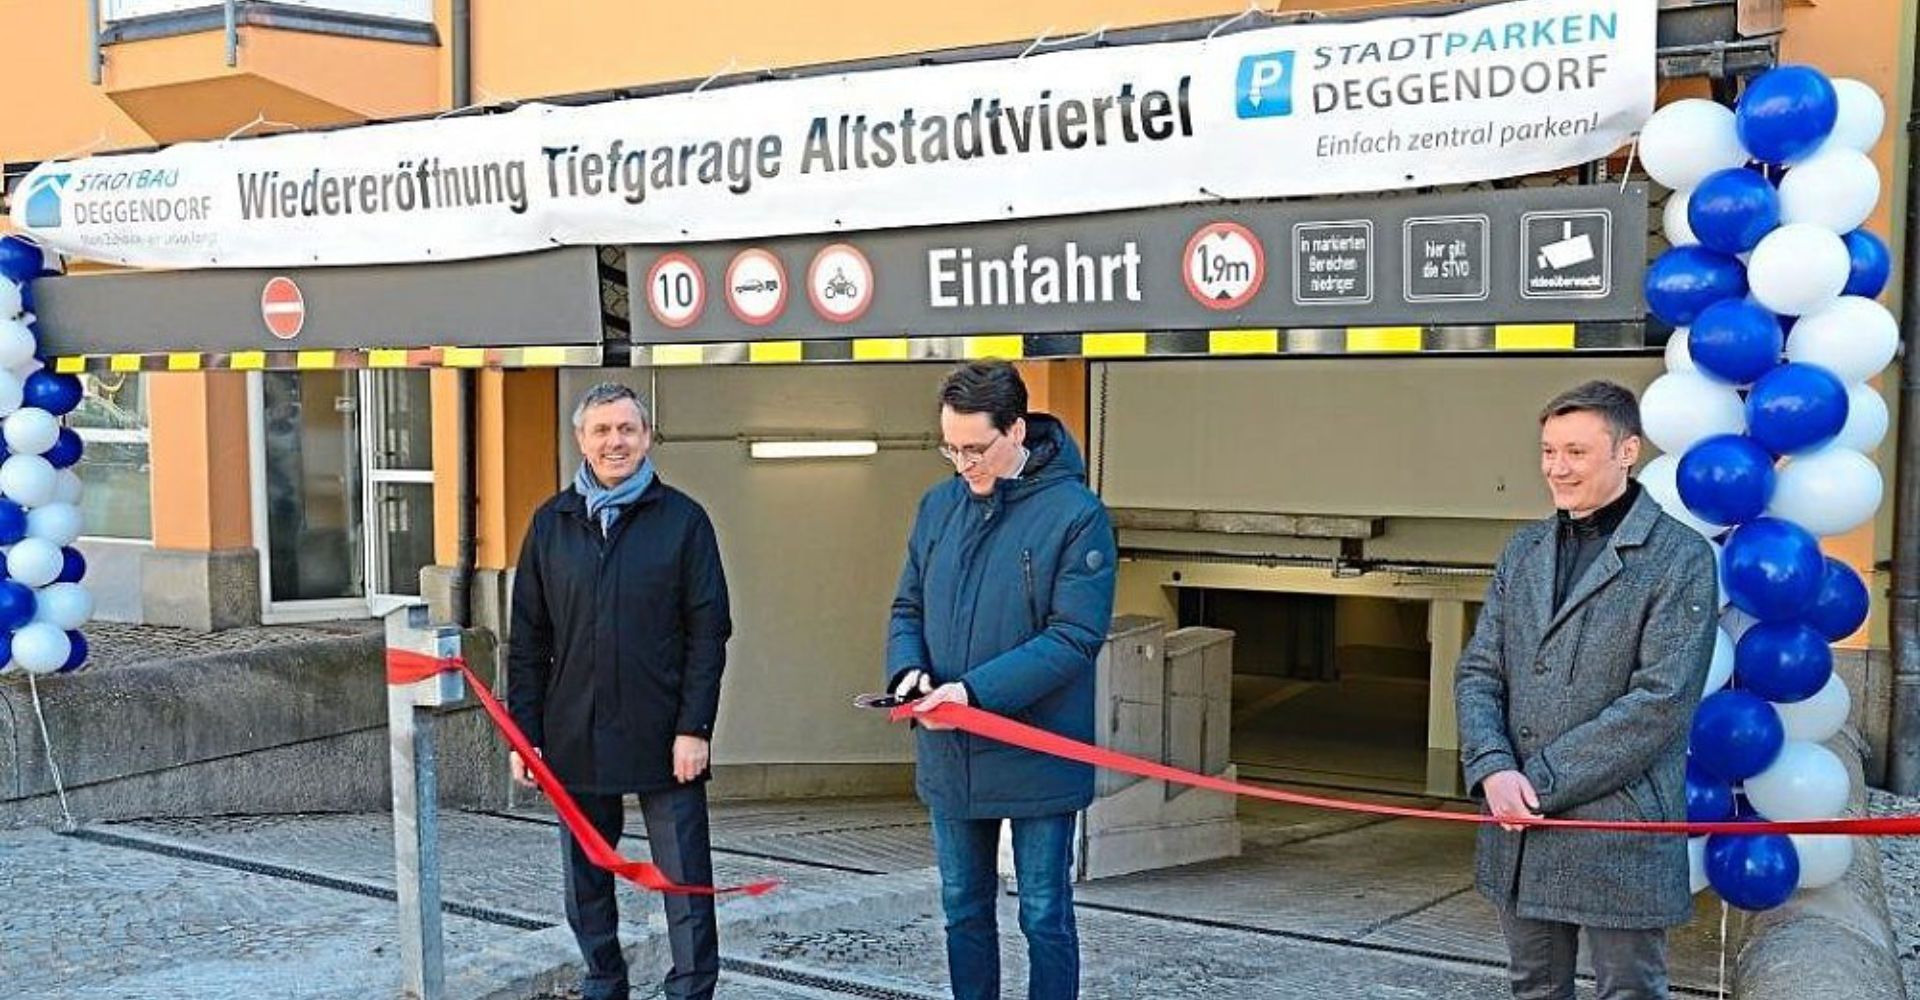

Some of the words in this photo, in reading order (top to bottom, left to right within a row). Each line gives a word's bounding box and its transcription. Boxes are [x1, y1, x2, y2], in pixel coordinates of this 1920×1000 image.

[1313, 11, 1618, 69] STADTPARKEN
[1312, 54, 1609, 115] DEGGENDORF
[237, 156, 528, 220] Wiedereröffnung
[542, 132, 782, 205] Tiefgarage
[800, 75, 1193, 174] Altstadtviertel
[1316, 125, 1401, 158] Einfach
[1407, 121, 1493, 150] zentral
[1500, 112, 1599, 146] parken!
[75, 168, 180, 192] STADTBAU
[74, 196, 212, 225] DEGGENDORF
[1300, 235, 1310, 253] in
[1312, 233, 1366, 252] markierten
[1425, 240, 1446, 258] hier
[1448, 239, 1467, 261] gilt
[928, 241, 1142, 307] Einfahrt
[1197, 243, 1249, 284] 1,9m
[1308, 254, 1358, 272] Bereichen
[1423, 260, 1439, 278] die
[658, 272, 693, 309] 10
[1310, 274, 1356, 295] niedriger
[1530, 274, 1601, 288] videoüberwacht
